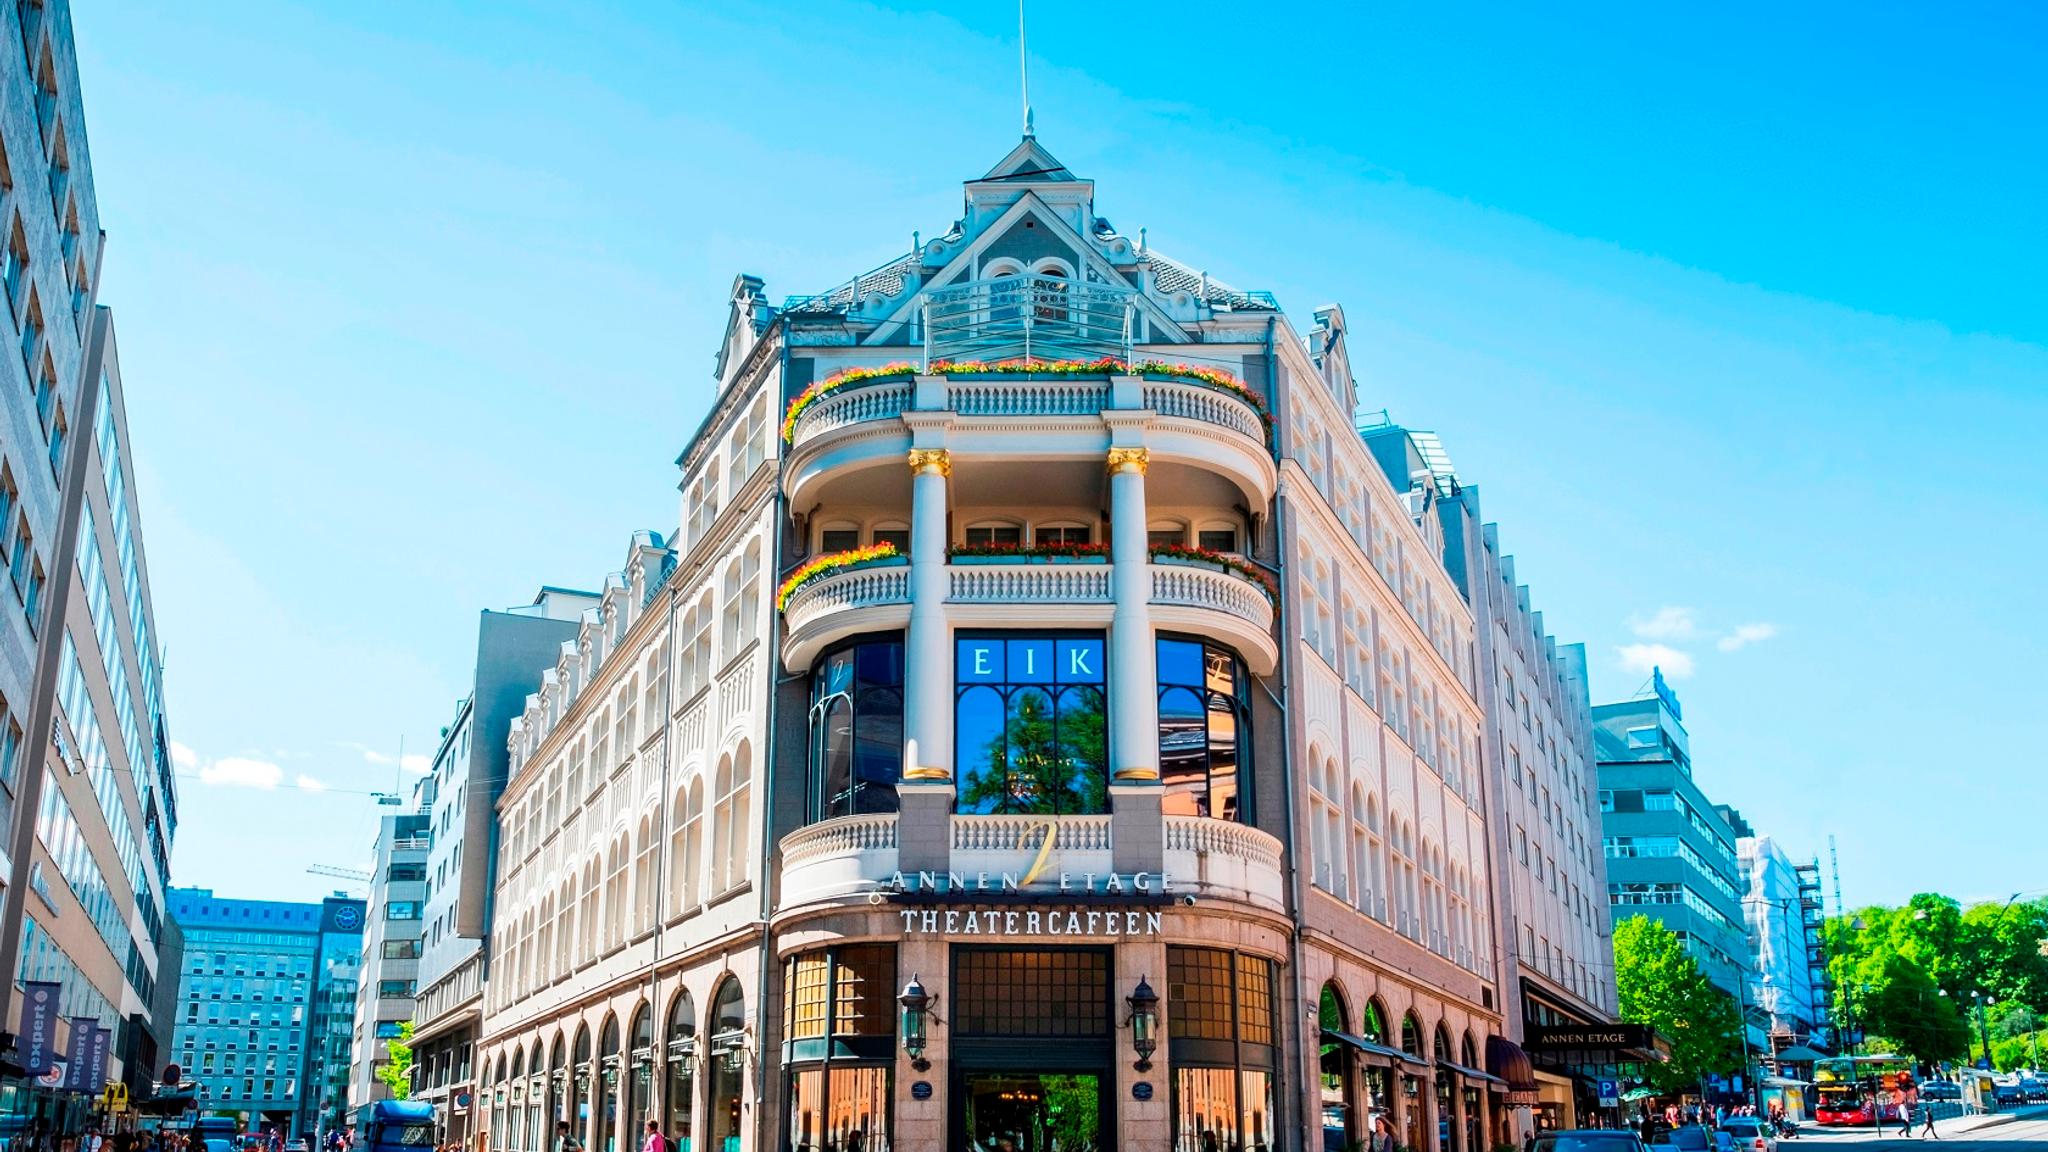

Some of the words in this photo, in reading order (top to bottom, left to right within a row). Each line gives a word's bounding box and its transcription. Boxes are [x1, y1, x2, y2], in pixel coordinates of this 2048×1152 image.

[974, 648, 1093, 675] EIK
[889, 870, 1019, 890] ANNEN
[1059, 872, 1174, 891] ETAGE
[900, 910, 1163, 936] THEATERCAFEEN
[30, 1004, 47, 1069] expert
[1542, 1034, 1584, 1044] ANNEN
[1588, 1033, 1626, 1043] ETAGE
[71, 1034, 88, 1086] expert
[90, 1043, 103, 1090] expert
[1602, 1082, 1612, 1095] P
